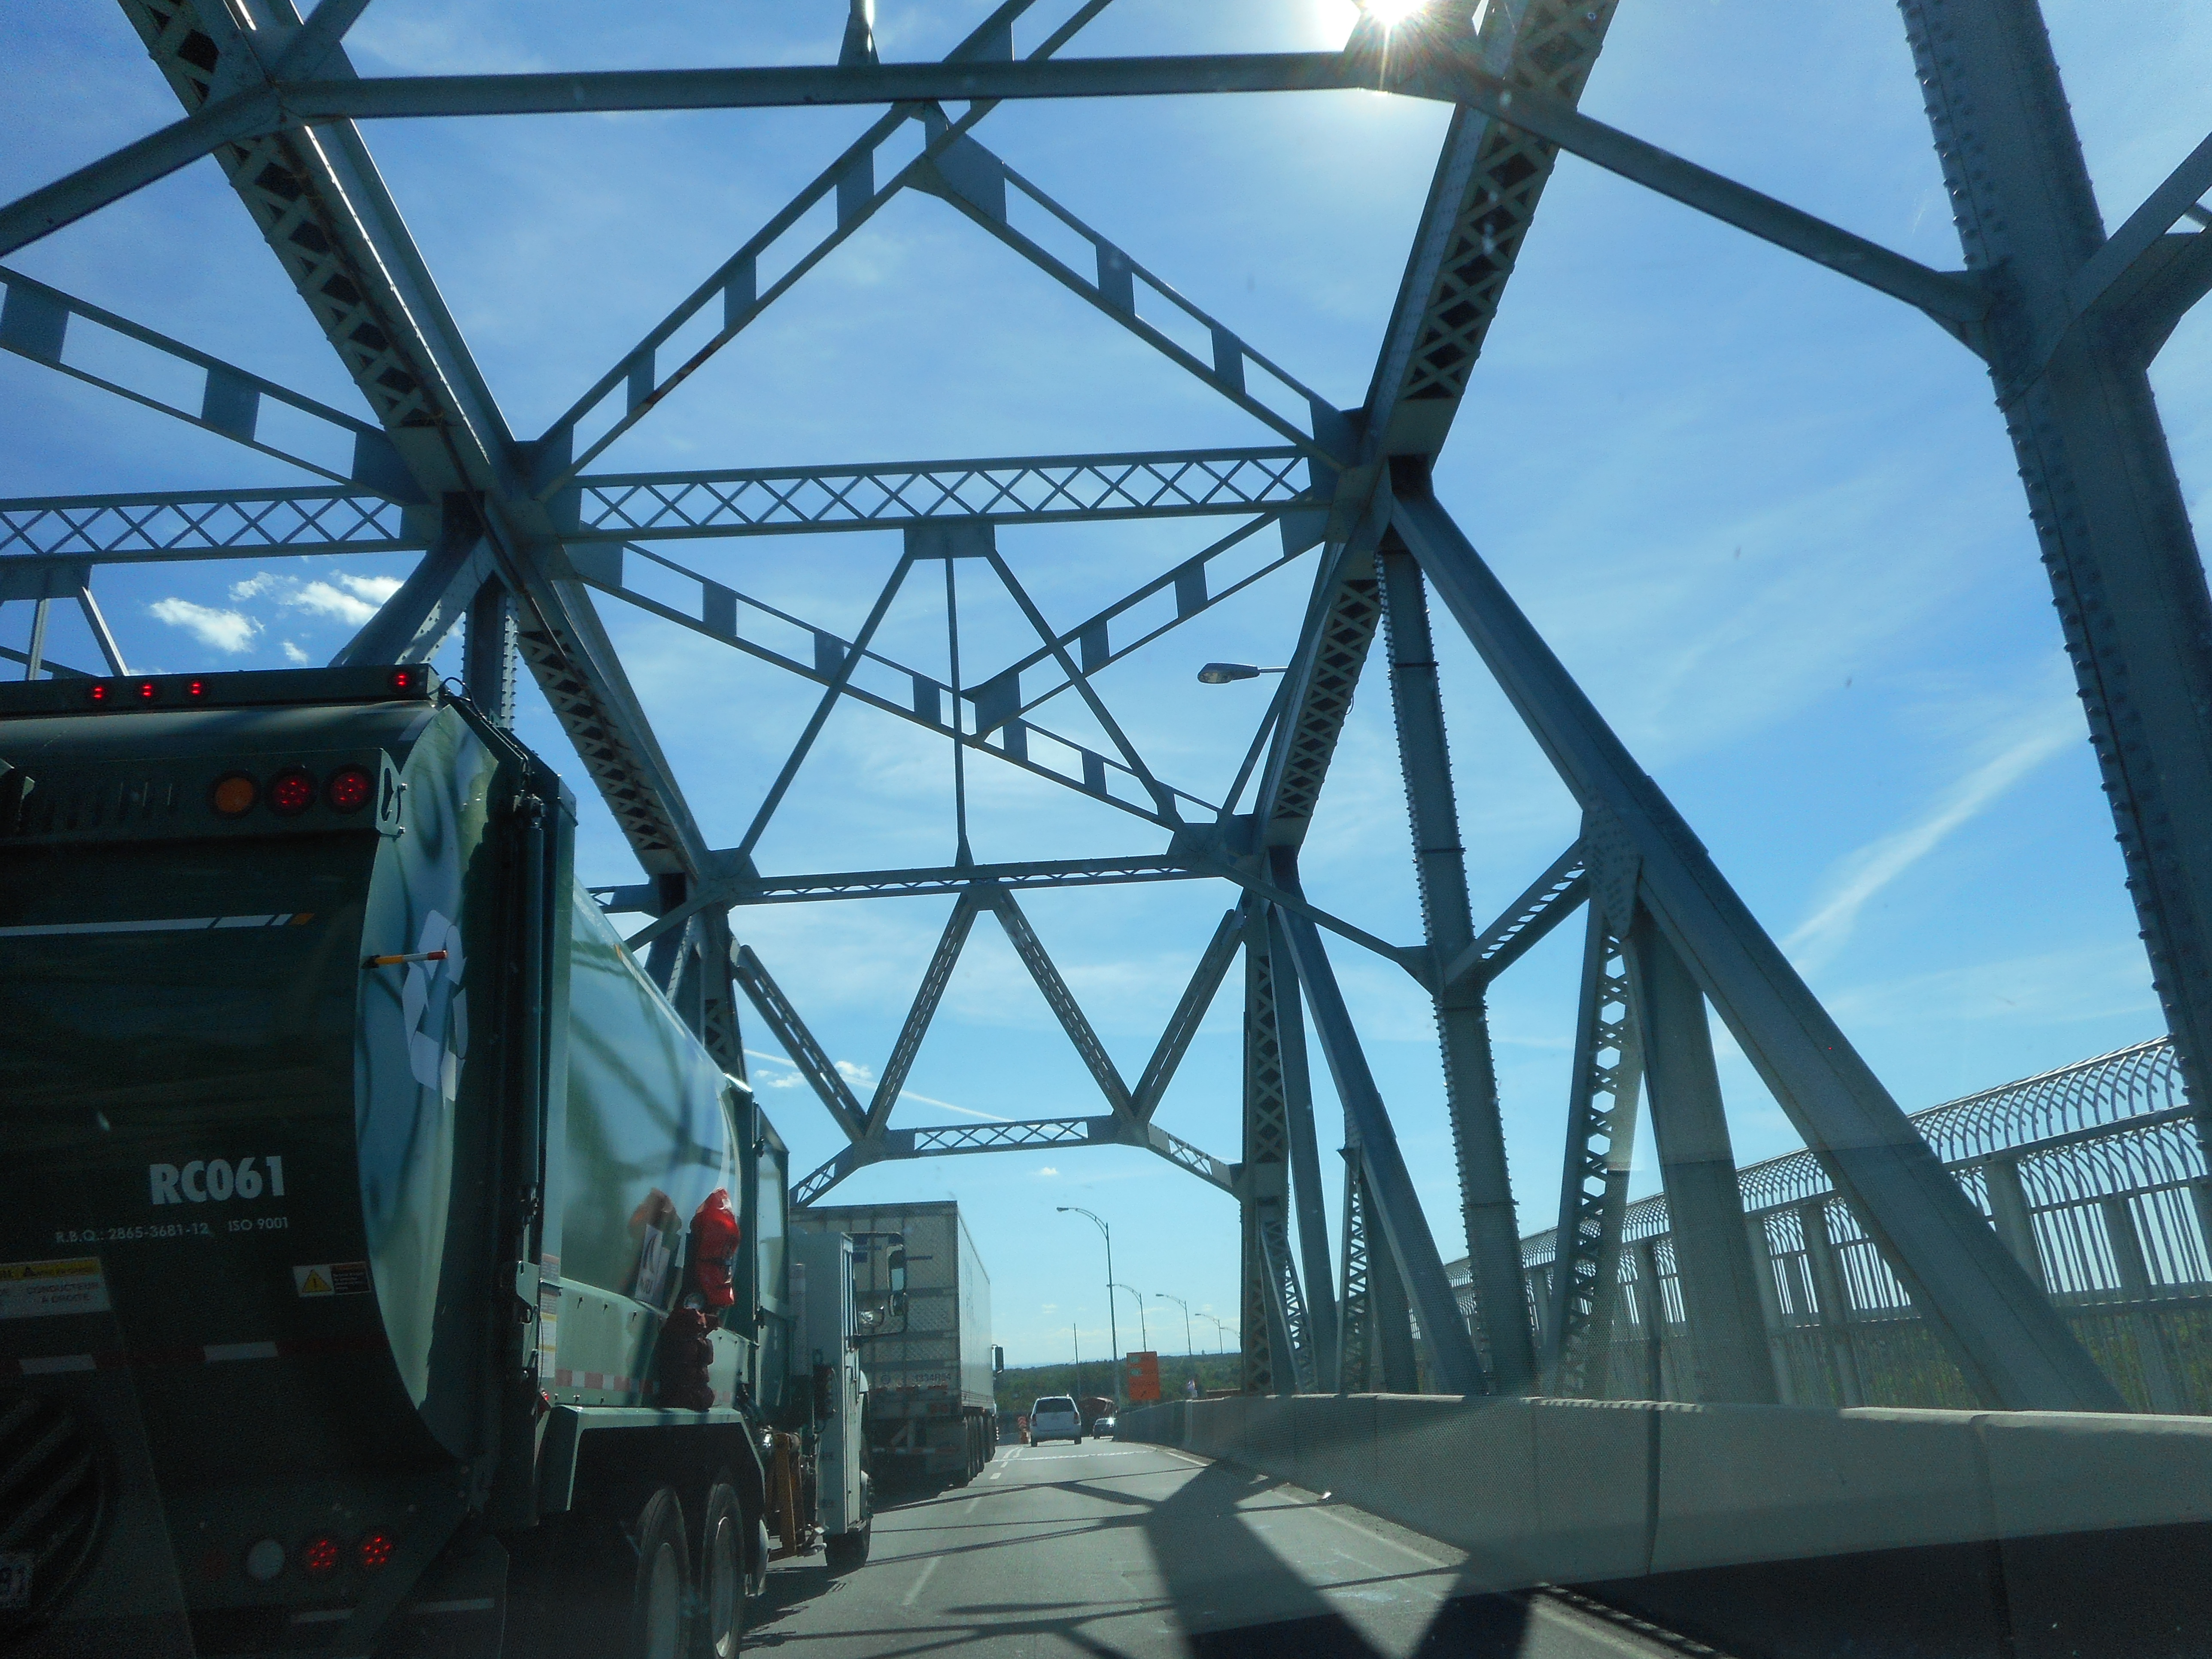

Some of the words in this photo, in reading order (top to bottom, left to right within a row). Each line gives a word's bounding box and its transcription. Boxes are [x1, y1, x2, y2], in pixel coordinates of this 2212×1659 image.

[149, 1155, 285, 1205] RC061
[108, 1223, 210, 1240] 2865-3681-12
[228, 1219, 252, 1232] ISO
[257, 1217, 289, 1230] 9001
